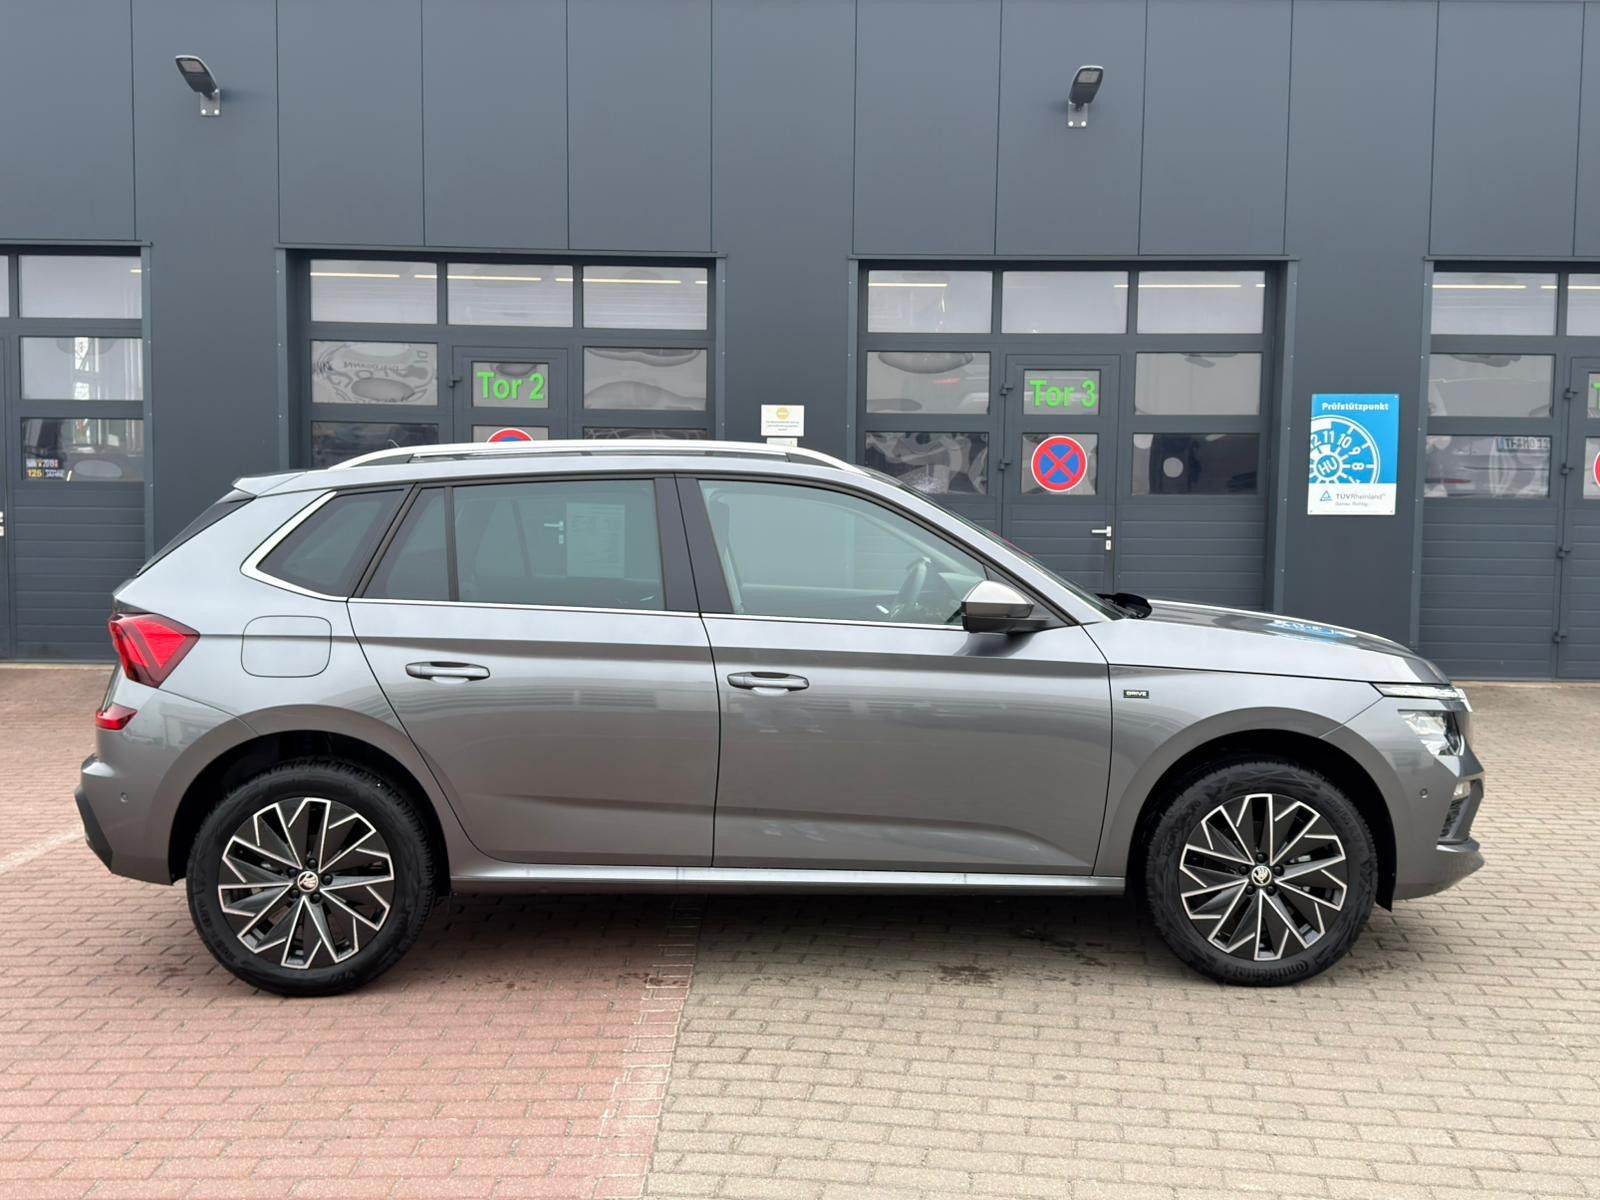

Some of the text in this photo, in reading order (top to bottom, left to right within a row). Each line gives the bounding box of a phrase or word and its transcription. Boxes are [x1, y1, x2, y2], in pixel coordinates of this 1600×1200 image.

[477, 371, 546, 400] Tor 2
[1029, 380, 1097, 408] Tor 3
[1321, 402, 1389, 412] Prüfstützpunkt
[1322, 430, 1336, 443] 11
[1337, 433, 1353, 449] 10
[1348, 446, 1361, 456] 9
[1317, 456, 1338, 476] HU
[1351, 462, 1365, 471] 8
